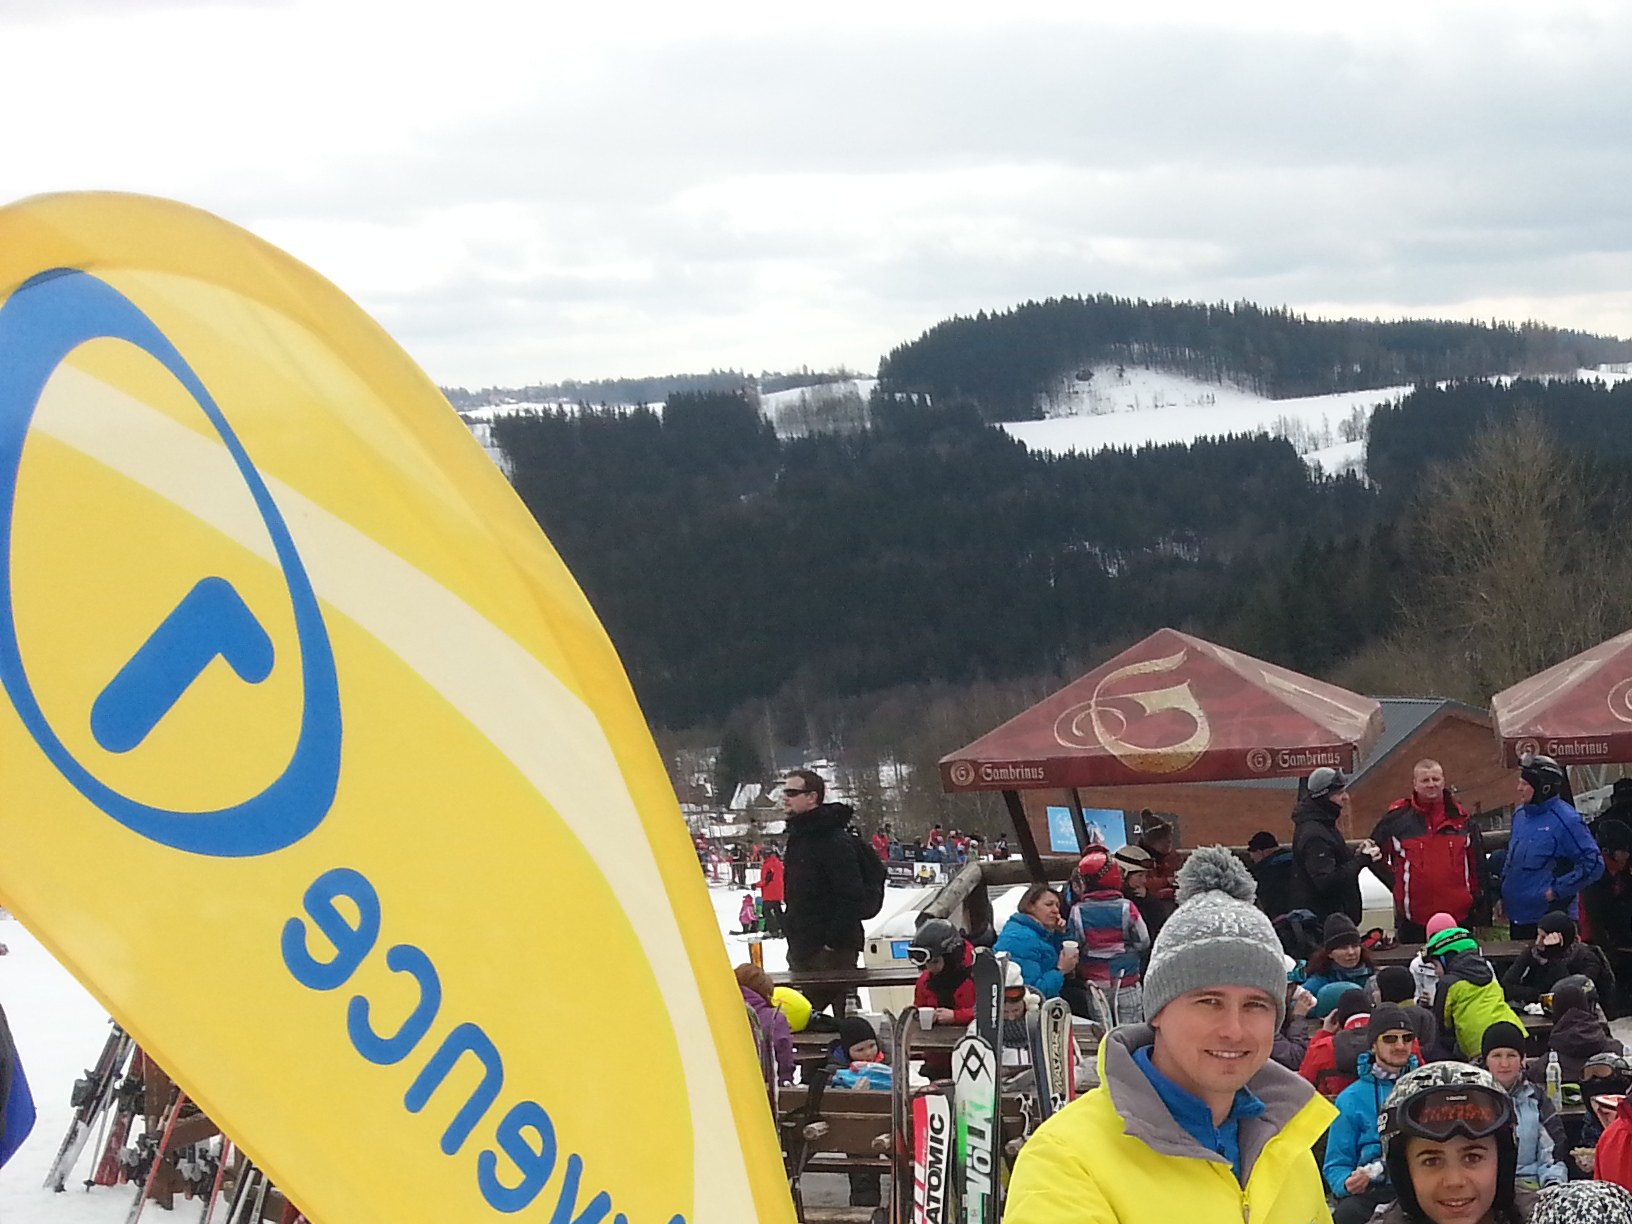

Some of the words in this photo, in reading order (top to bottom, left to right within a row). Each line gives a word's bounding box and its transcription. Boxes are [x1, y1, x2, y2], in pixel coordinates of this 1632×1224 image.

[1547, 740, 1609, 757] Gambrinus
[1279, 750, 1341, 768] Gambrinus
[980, 764, 1044, 781] Gambrinus
